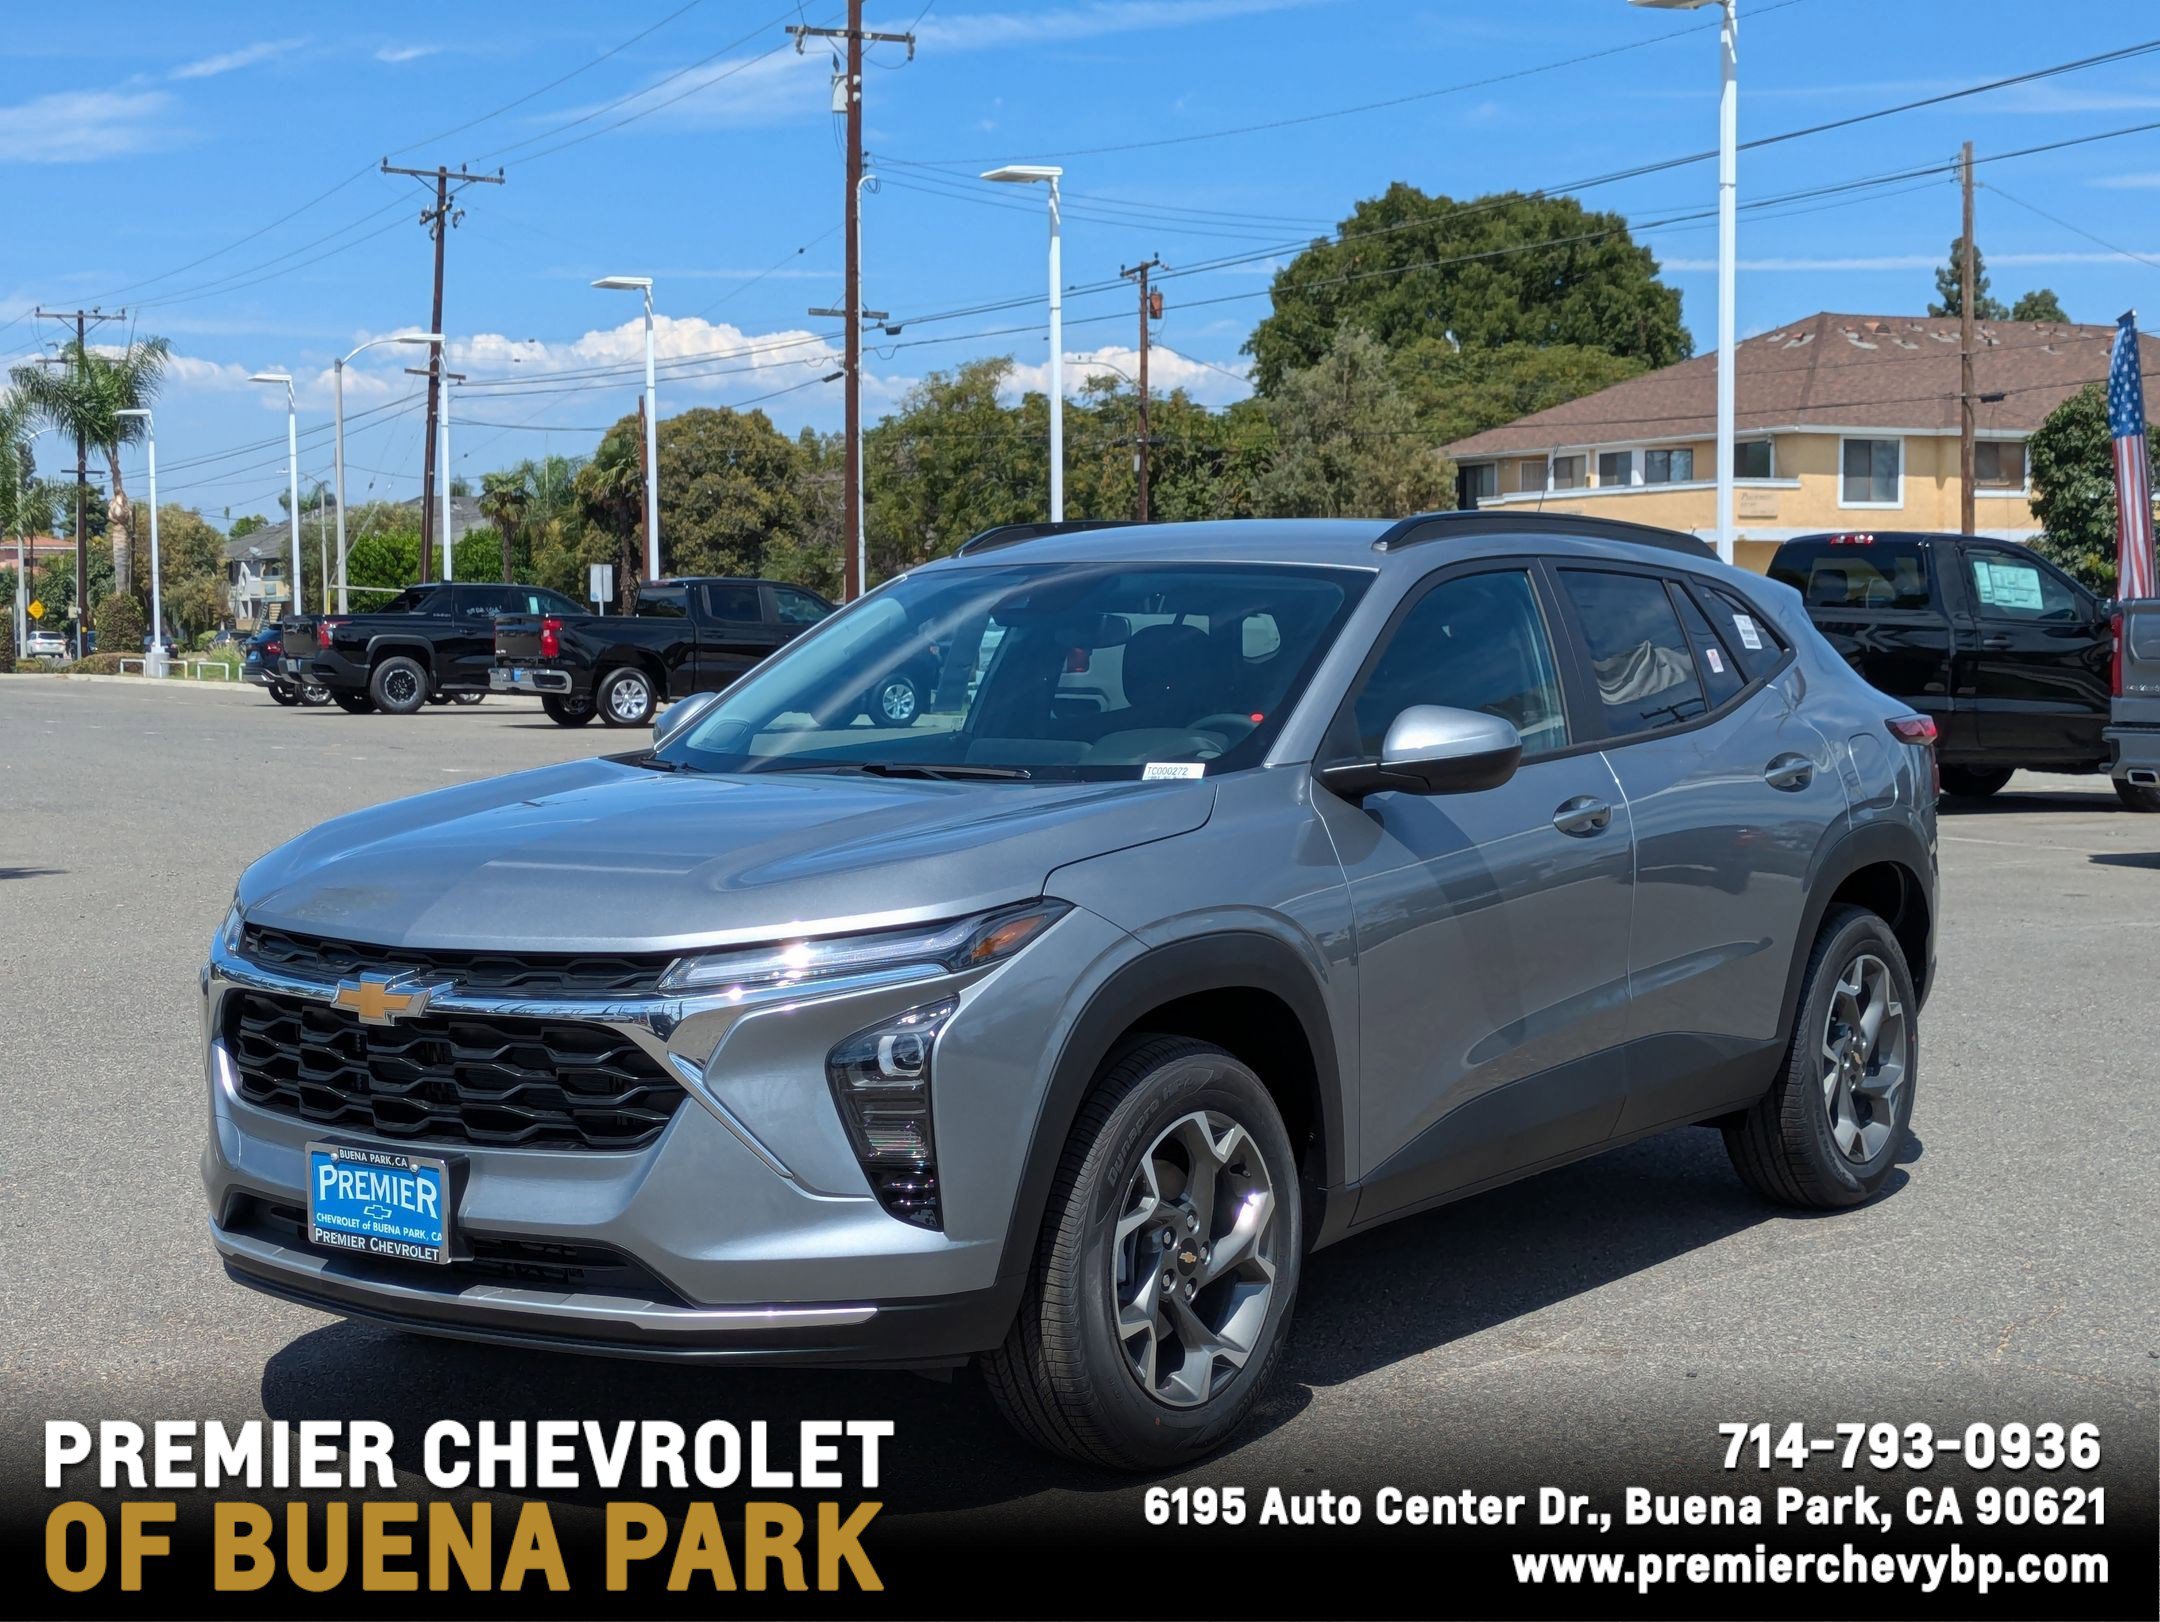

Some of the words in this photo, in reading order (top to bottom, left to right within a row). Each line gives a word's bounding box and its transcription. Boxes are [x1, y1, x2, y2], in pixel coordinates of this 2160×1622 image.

[1147, 766, 1189, 776] TC000272
[339, 1149, 367, 1162] BUENA
[318, 1164, 438, 1220] PREMIER
[316, 1212, 360, 1229] CHEVROLET
[362, 1220, 371, 1230] of
[373, 1221, 401, 1236] BUENA
[403, 1228, 428, 1241] PARK,
[431, 1231, 442, 1242] CA
[315, 1228, 366, 1250] PREMIER
[370, 1237, 440, 1261] CHEVROLET
